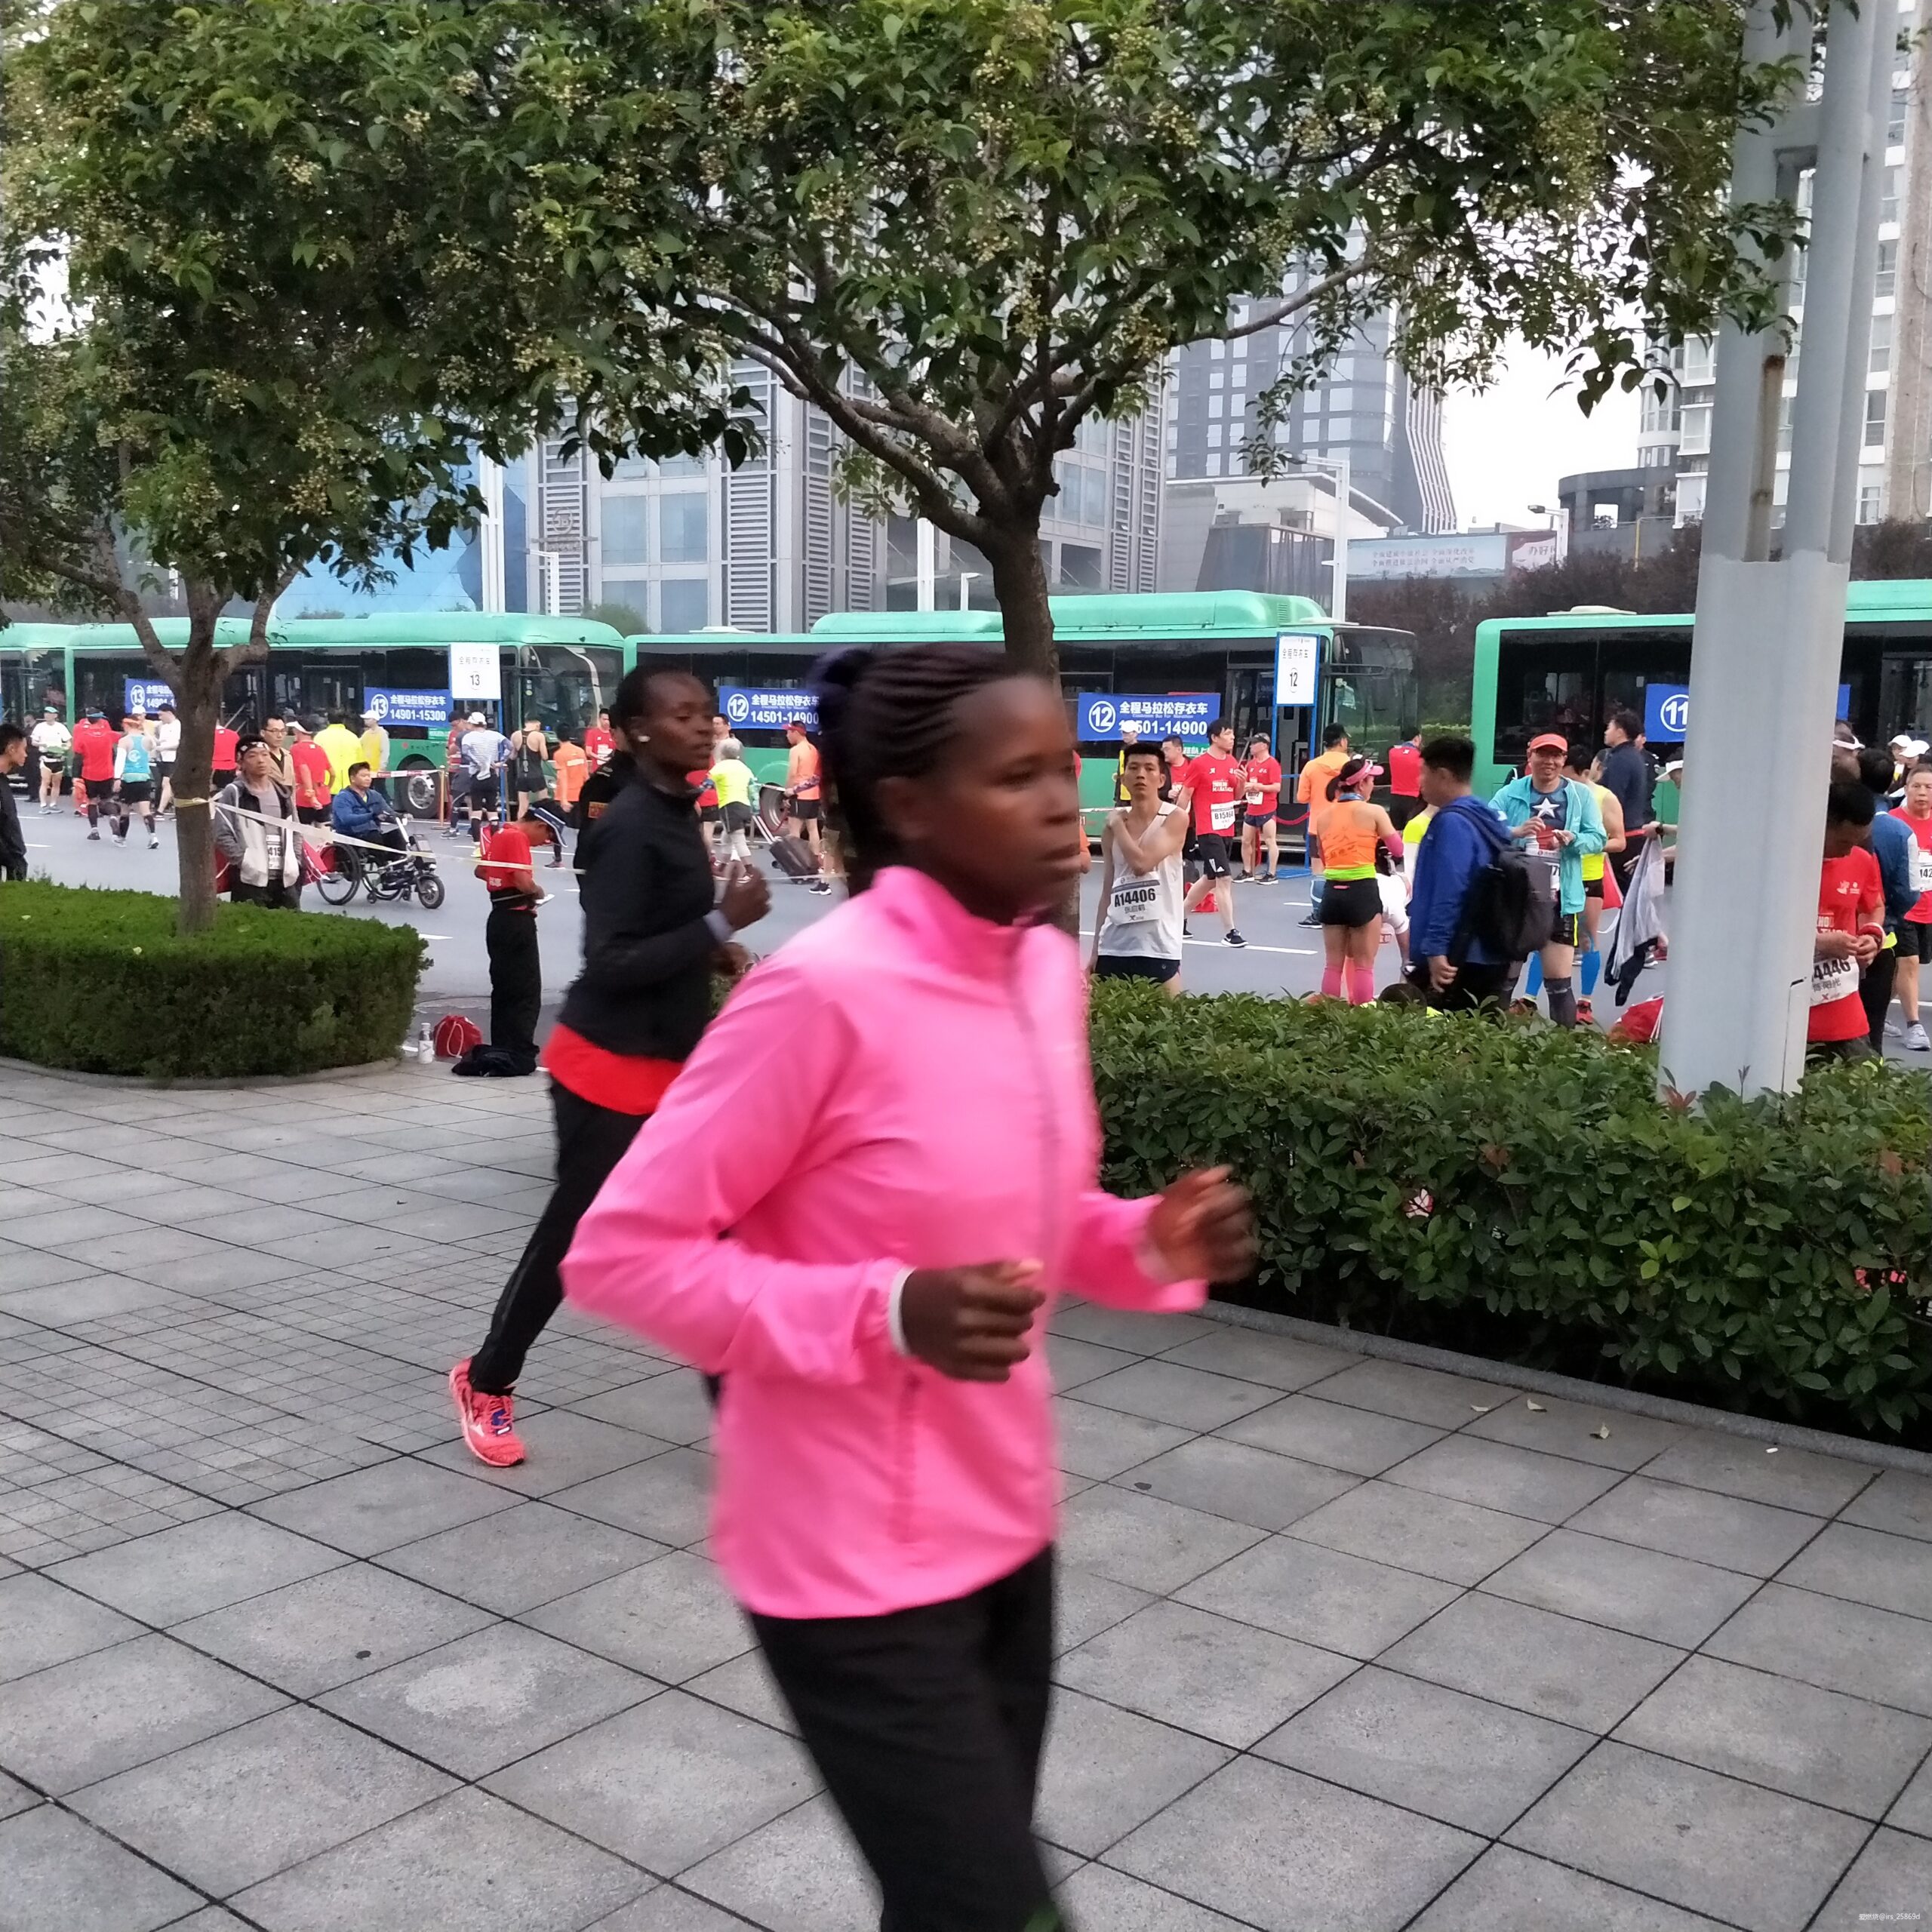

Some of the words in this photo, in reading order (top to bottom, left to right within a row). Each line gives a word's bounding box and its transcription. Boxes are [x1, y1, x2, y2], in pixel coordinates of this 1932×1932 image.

[469, 674, 480, 686] 13
[1289, 672, 1298, 687] 12
[389, 694, 447, 706] 全程马拉松存衣车
[729, 698, 746, 717] 12
[751, 694, 820, 706] 全程马拉松存衣车
[389, 709, 446, 721] 14901-15300
[1119, 701, 1208, 715] 全程马拉松存衣车
[1665, 700, 1689, 725] 11
[750, 710, 820, 724] 14501-14900
[1091, 706, 1113, 727] 12
[1118, 720, 1208, 735] 501-14900
[1114, 888, 1156, 908] A14406
[1813, 959, 1851, 980] 4446
